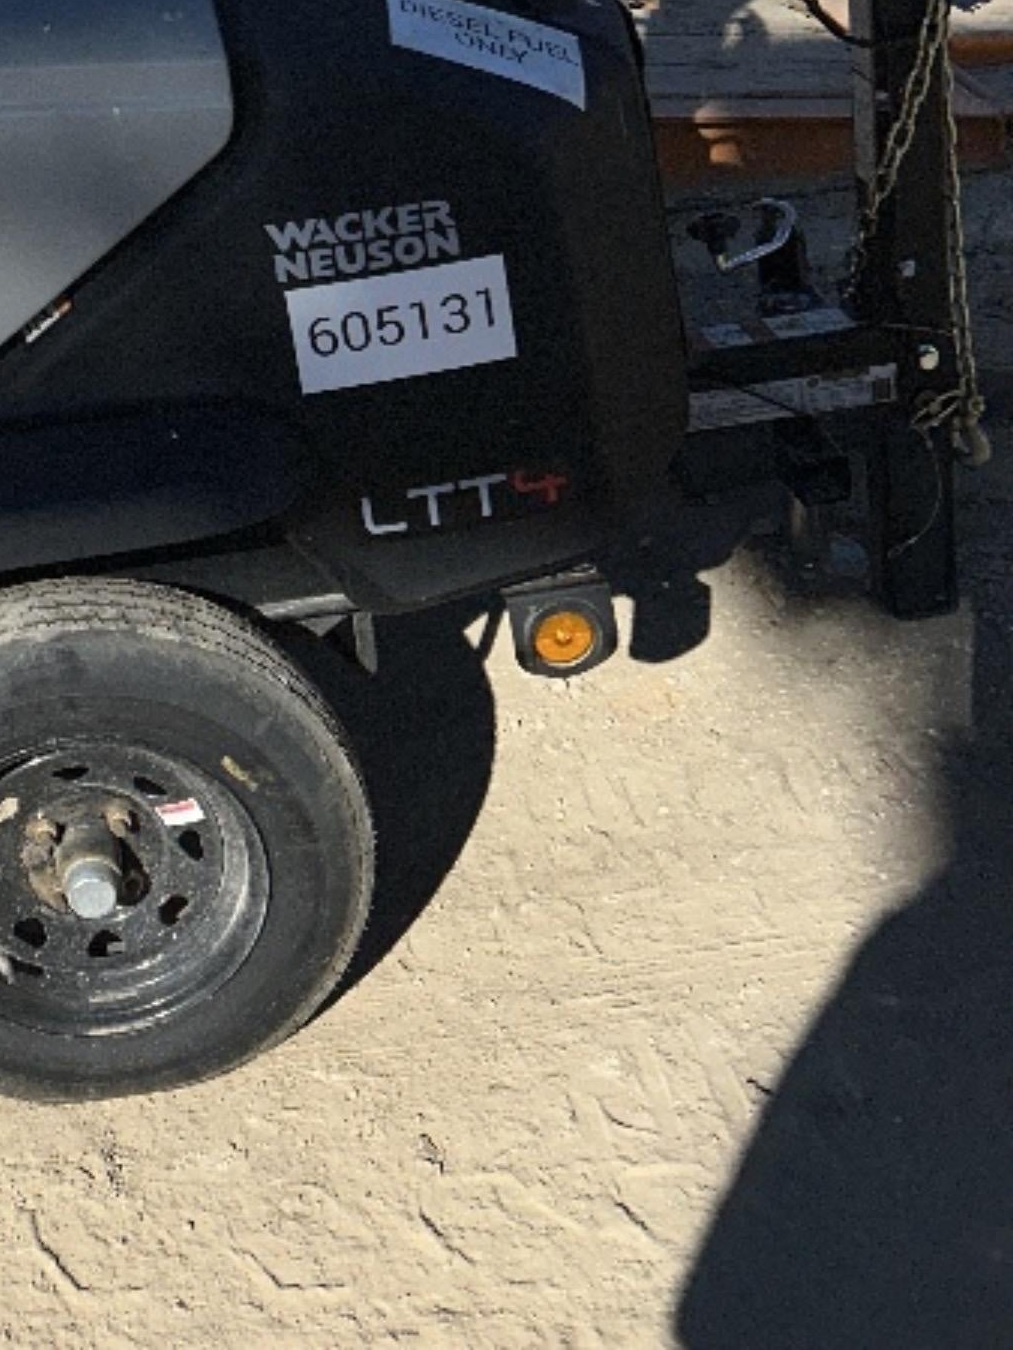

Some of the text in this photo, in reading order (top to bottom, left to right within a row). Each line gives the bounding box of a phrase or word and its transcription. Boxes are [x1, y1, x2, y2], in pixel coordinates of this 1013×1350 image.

[454, 31, 528, 64] ONLY
[508, 29, 579, 67] FUEL
[263, 200, 456, 252] WACKER
[273, 227, 461, 283] NEUSON
[308, 286, 495, 357] 605131
